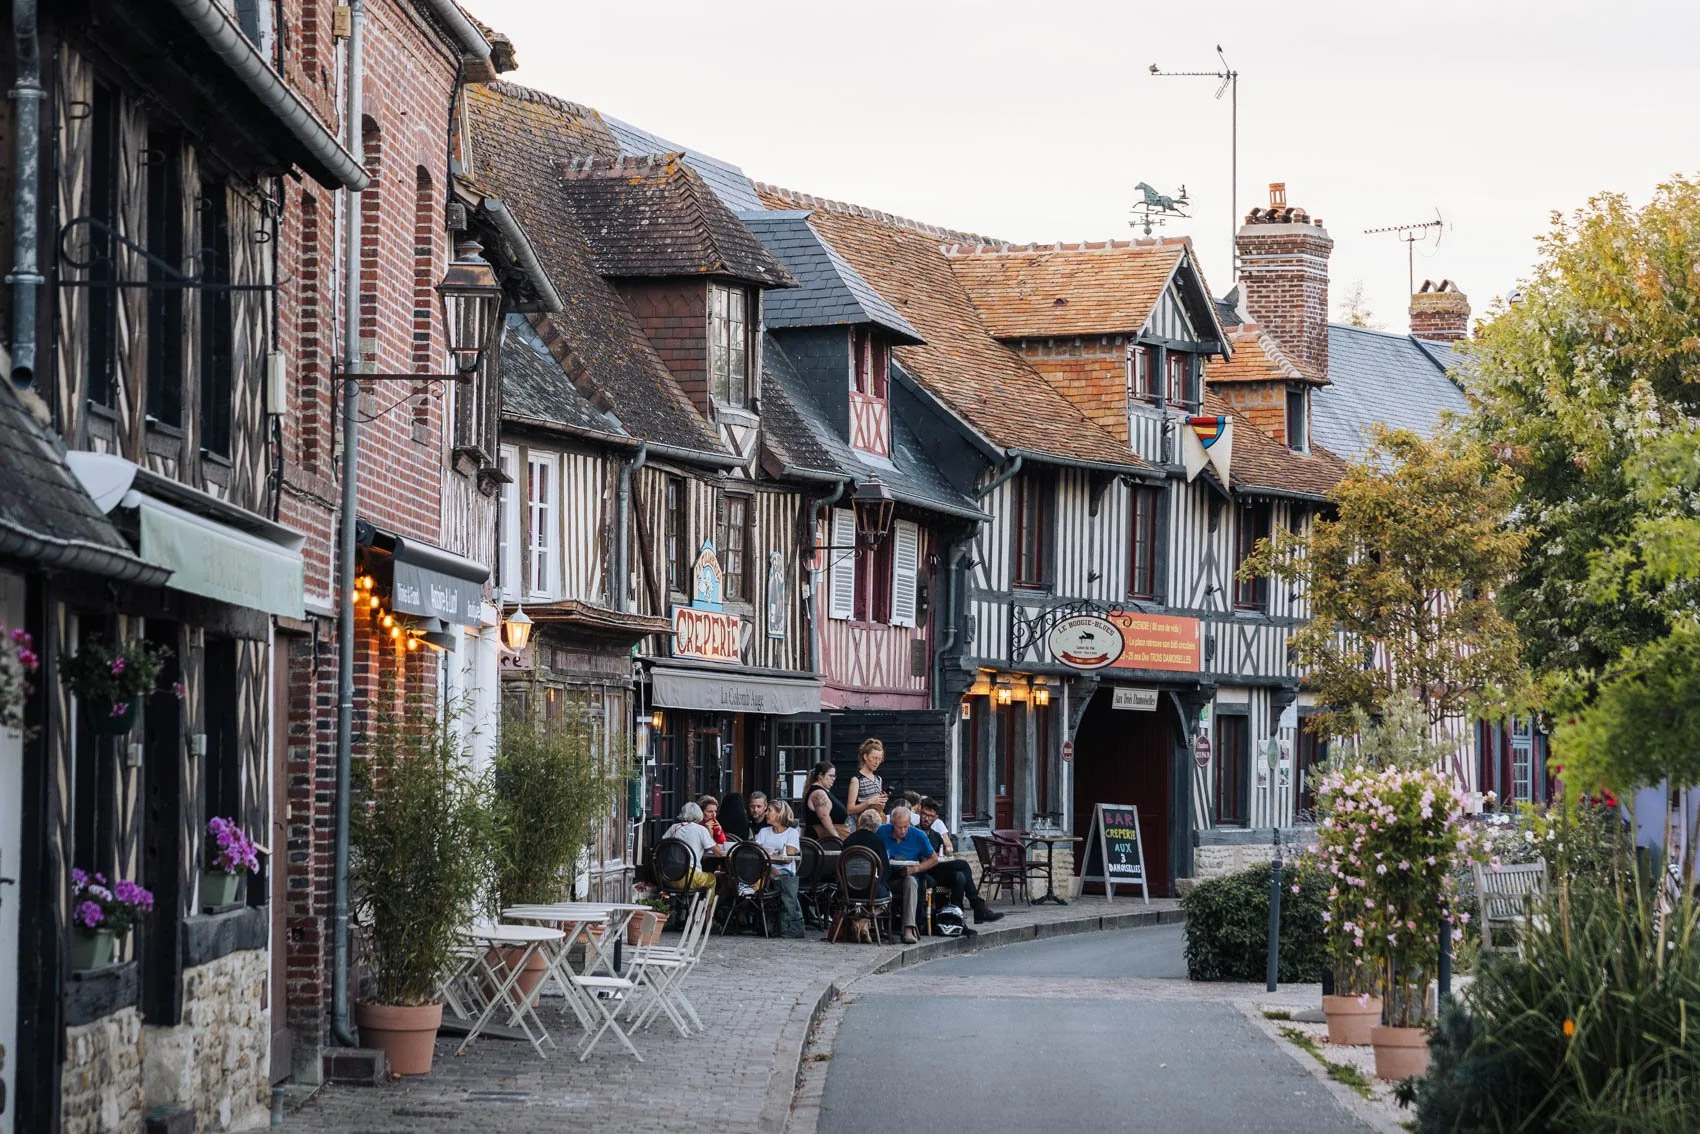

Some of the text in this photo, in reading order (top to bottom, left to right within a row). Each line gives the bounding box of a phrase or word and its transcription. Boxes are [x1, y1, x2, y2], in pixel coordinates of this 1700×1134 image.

[1058, 625, 1067, 634] LE
[721, 686, 728, 704] La
[1104, 812, 1133, 826] BAR
[1105, 828, 1136, 840] CREPERIE
[1114, 843, 1132, 853] AUX
[1120, 853, 1126, 863] 3
